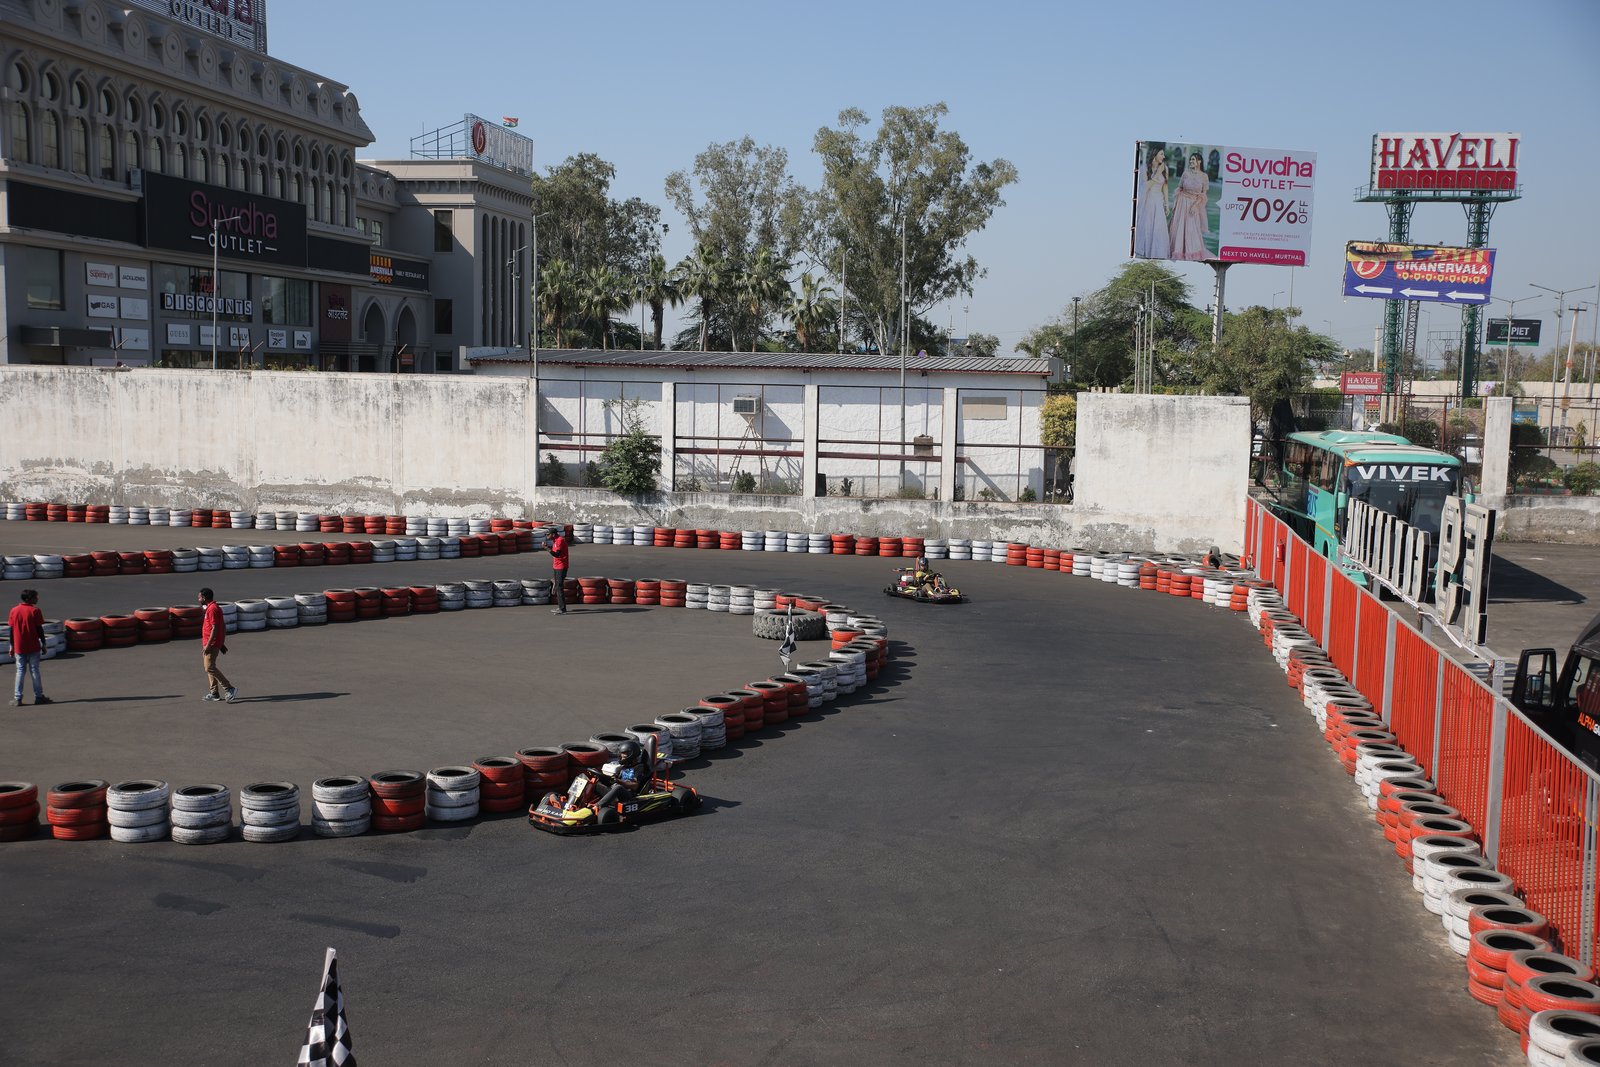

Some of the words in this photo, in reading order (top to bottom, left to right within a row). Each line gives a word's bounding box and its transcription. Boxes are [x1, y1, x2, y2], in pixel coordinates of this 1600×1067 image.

[1378, 132, 1518, 169] HAVELI
[1225, 152, 1312, 178] Suvidha
[1241, 177, 1295, 190] OUTLET
[190, 190, 277, 238] Suvidha
[1225, 203, 1244, 211] UPTO
[1237, 197, 1298, 224] 70%
[1298, 200, 1309, 224] OFF
[208, 233, 262, 254] OUTLET
[1395, 261, 1488, 275] BIKANERVALA
[101, 302, 115, 310] GAS
[165, 294, 251, 314] DISCOUNTS
[169, 330, 188, 338] GUESS
[1511, 326, 1530, 336] PIET
[1347, 376, 1378, 384] HAVELI
[1356, 465, 1452, 482] VIVEK
[625, 803, 639, 812] 38
